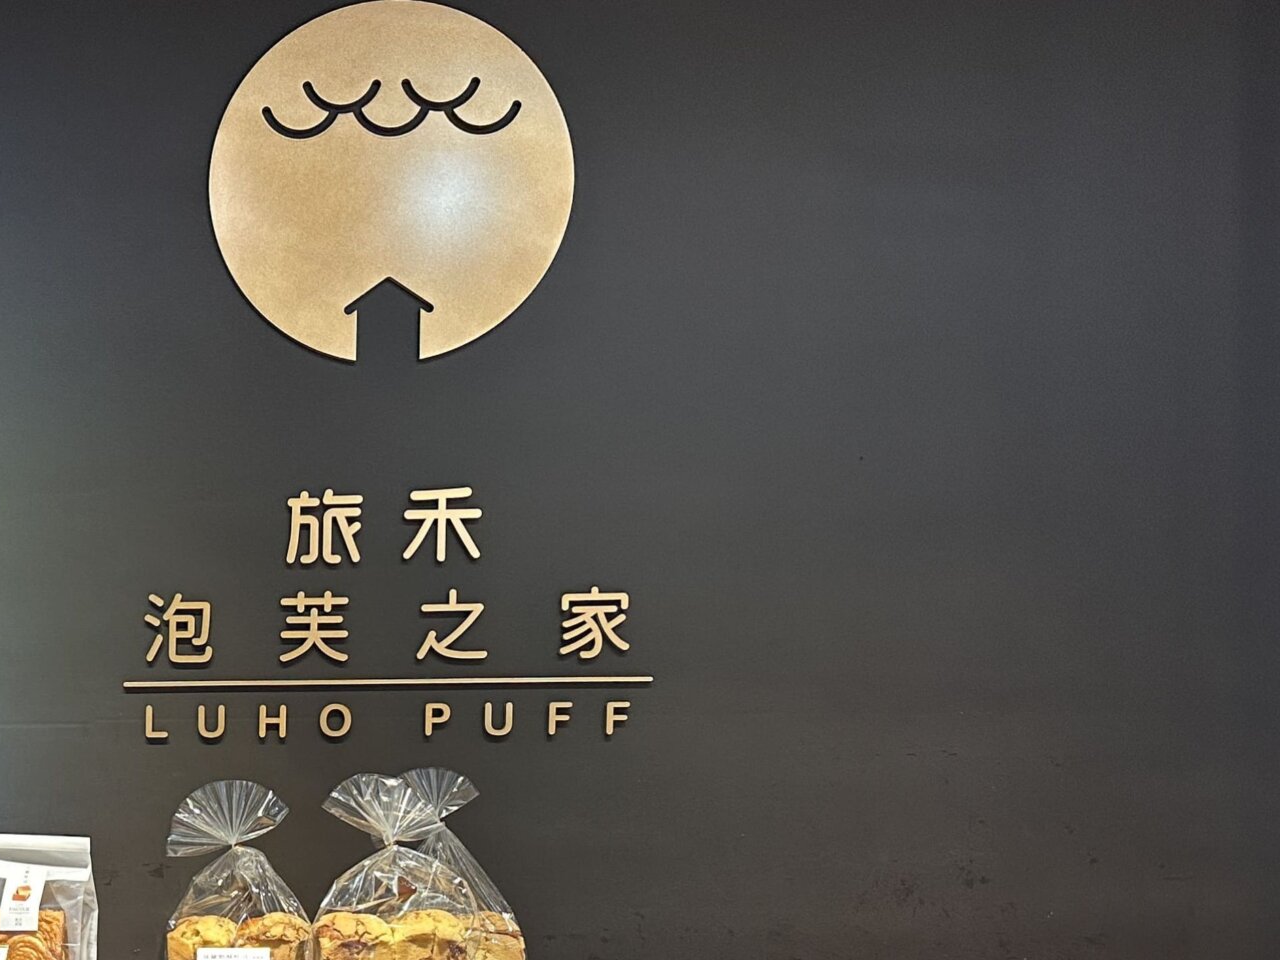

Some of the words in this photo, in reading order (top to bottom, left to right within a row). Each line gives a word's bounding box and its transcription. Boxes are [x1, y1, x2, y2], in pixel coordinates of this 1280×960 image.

[286, 486, 483, 564] 旅禾
[143, 586, 631, 664] 泡芙之家
[144, 703, 352, 739] LUHO
[424, 701, 631, 737] PUFF
